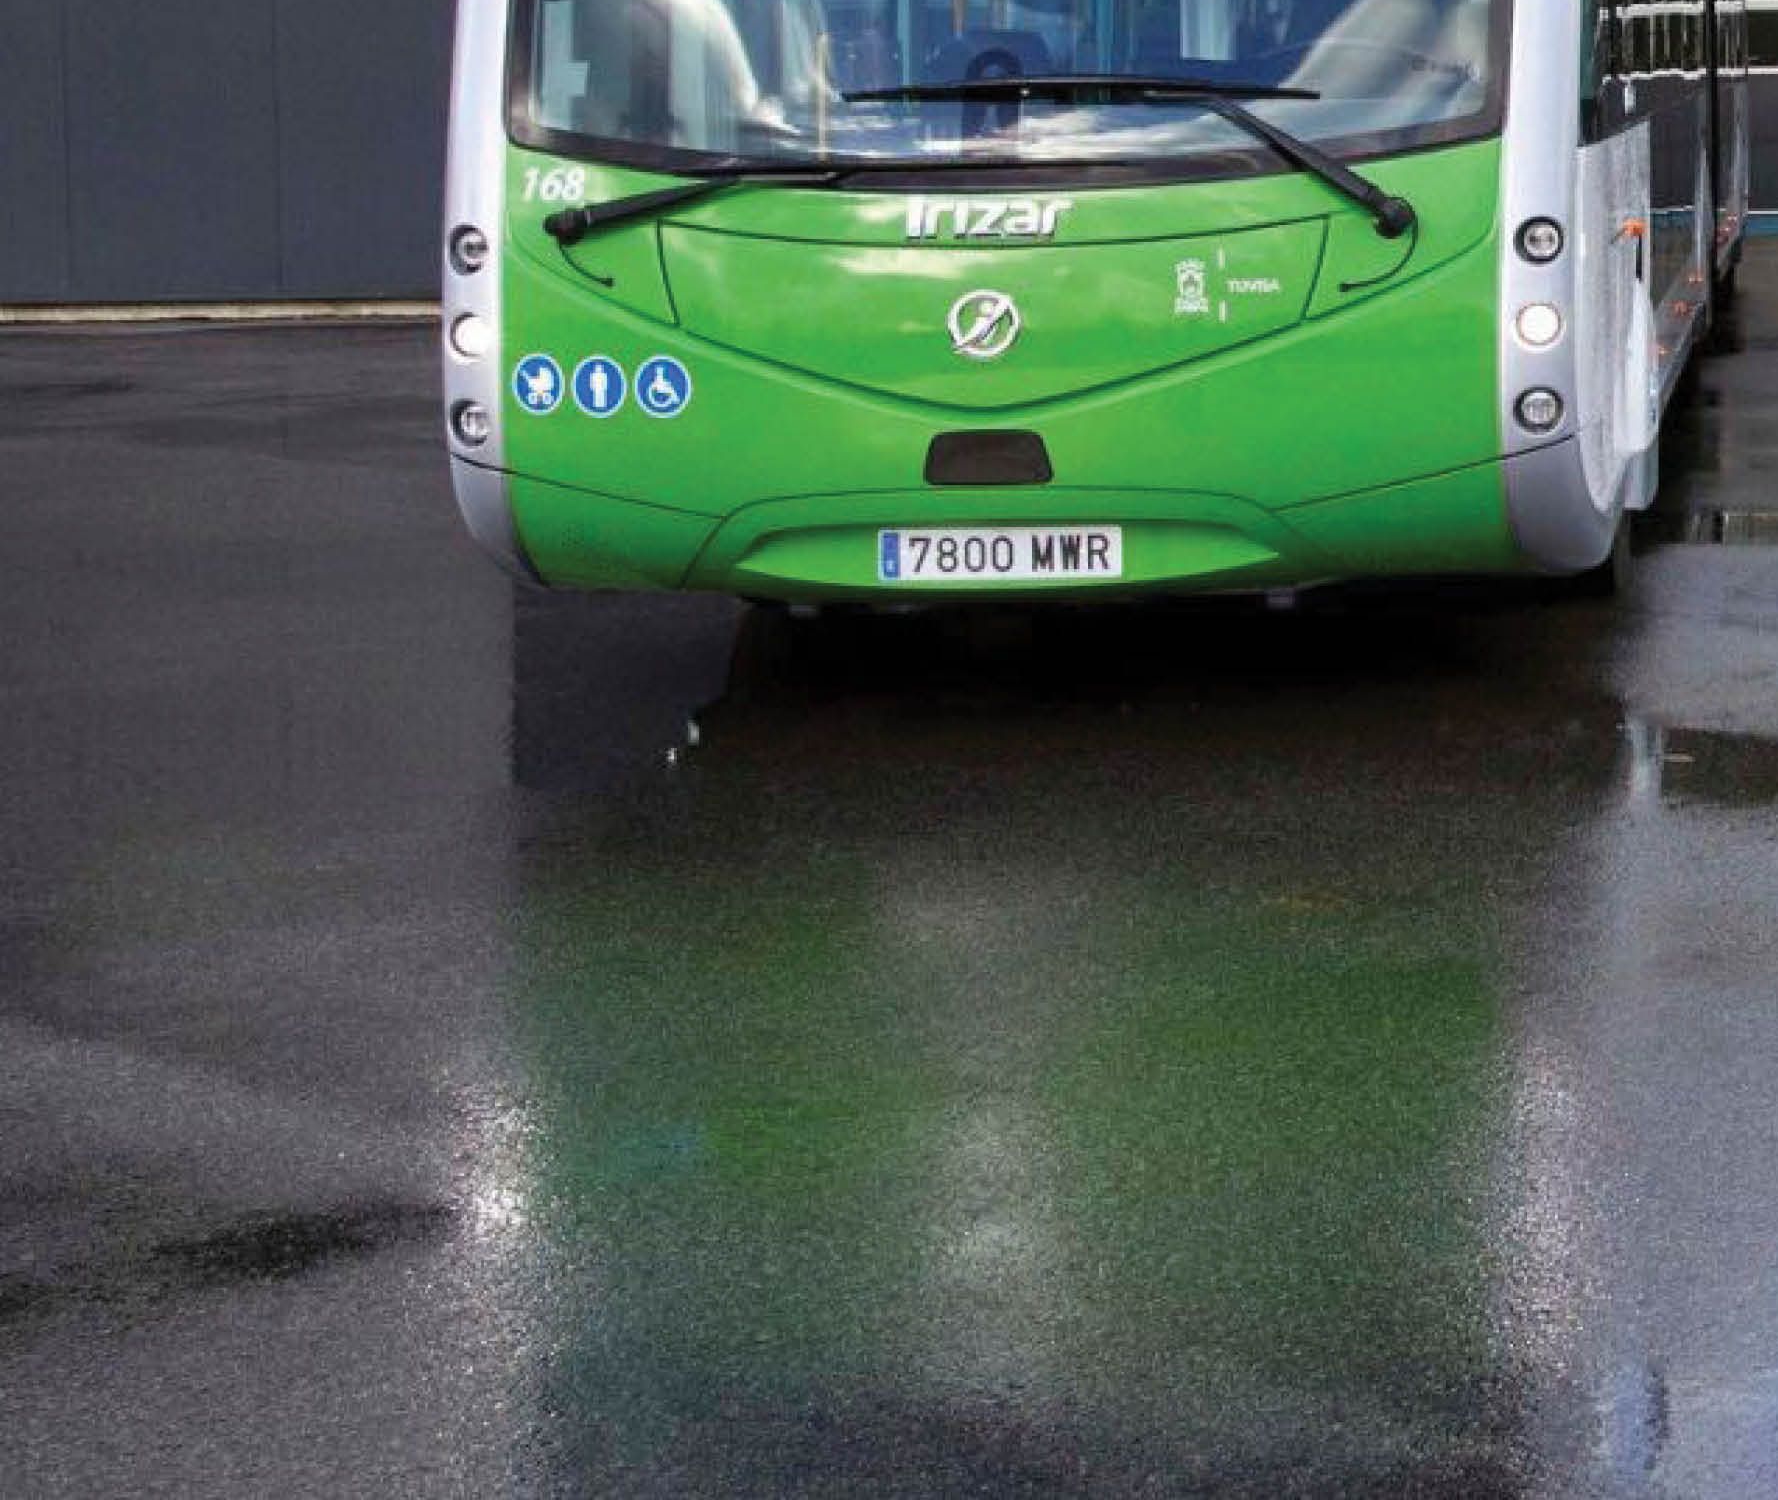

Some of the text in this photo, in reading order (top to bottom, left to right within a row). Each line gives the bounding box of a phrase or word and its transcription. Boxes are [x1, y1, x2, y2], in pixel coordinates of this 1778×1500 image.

[521, 166, 585, 202] 168
[908, 533, 1111, 574] 7800 MWR
